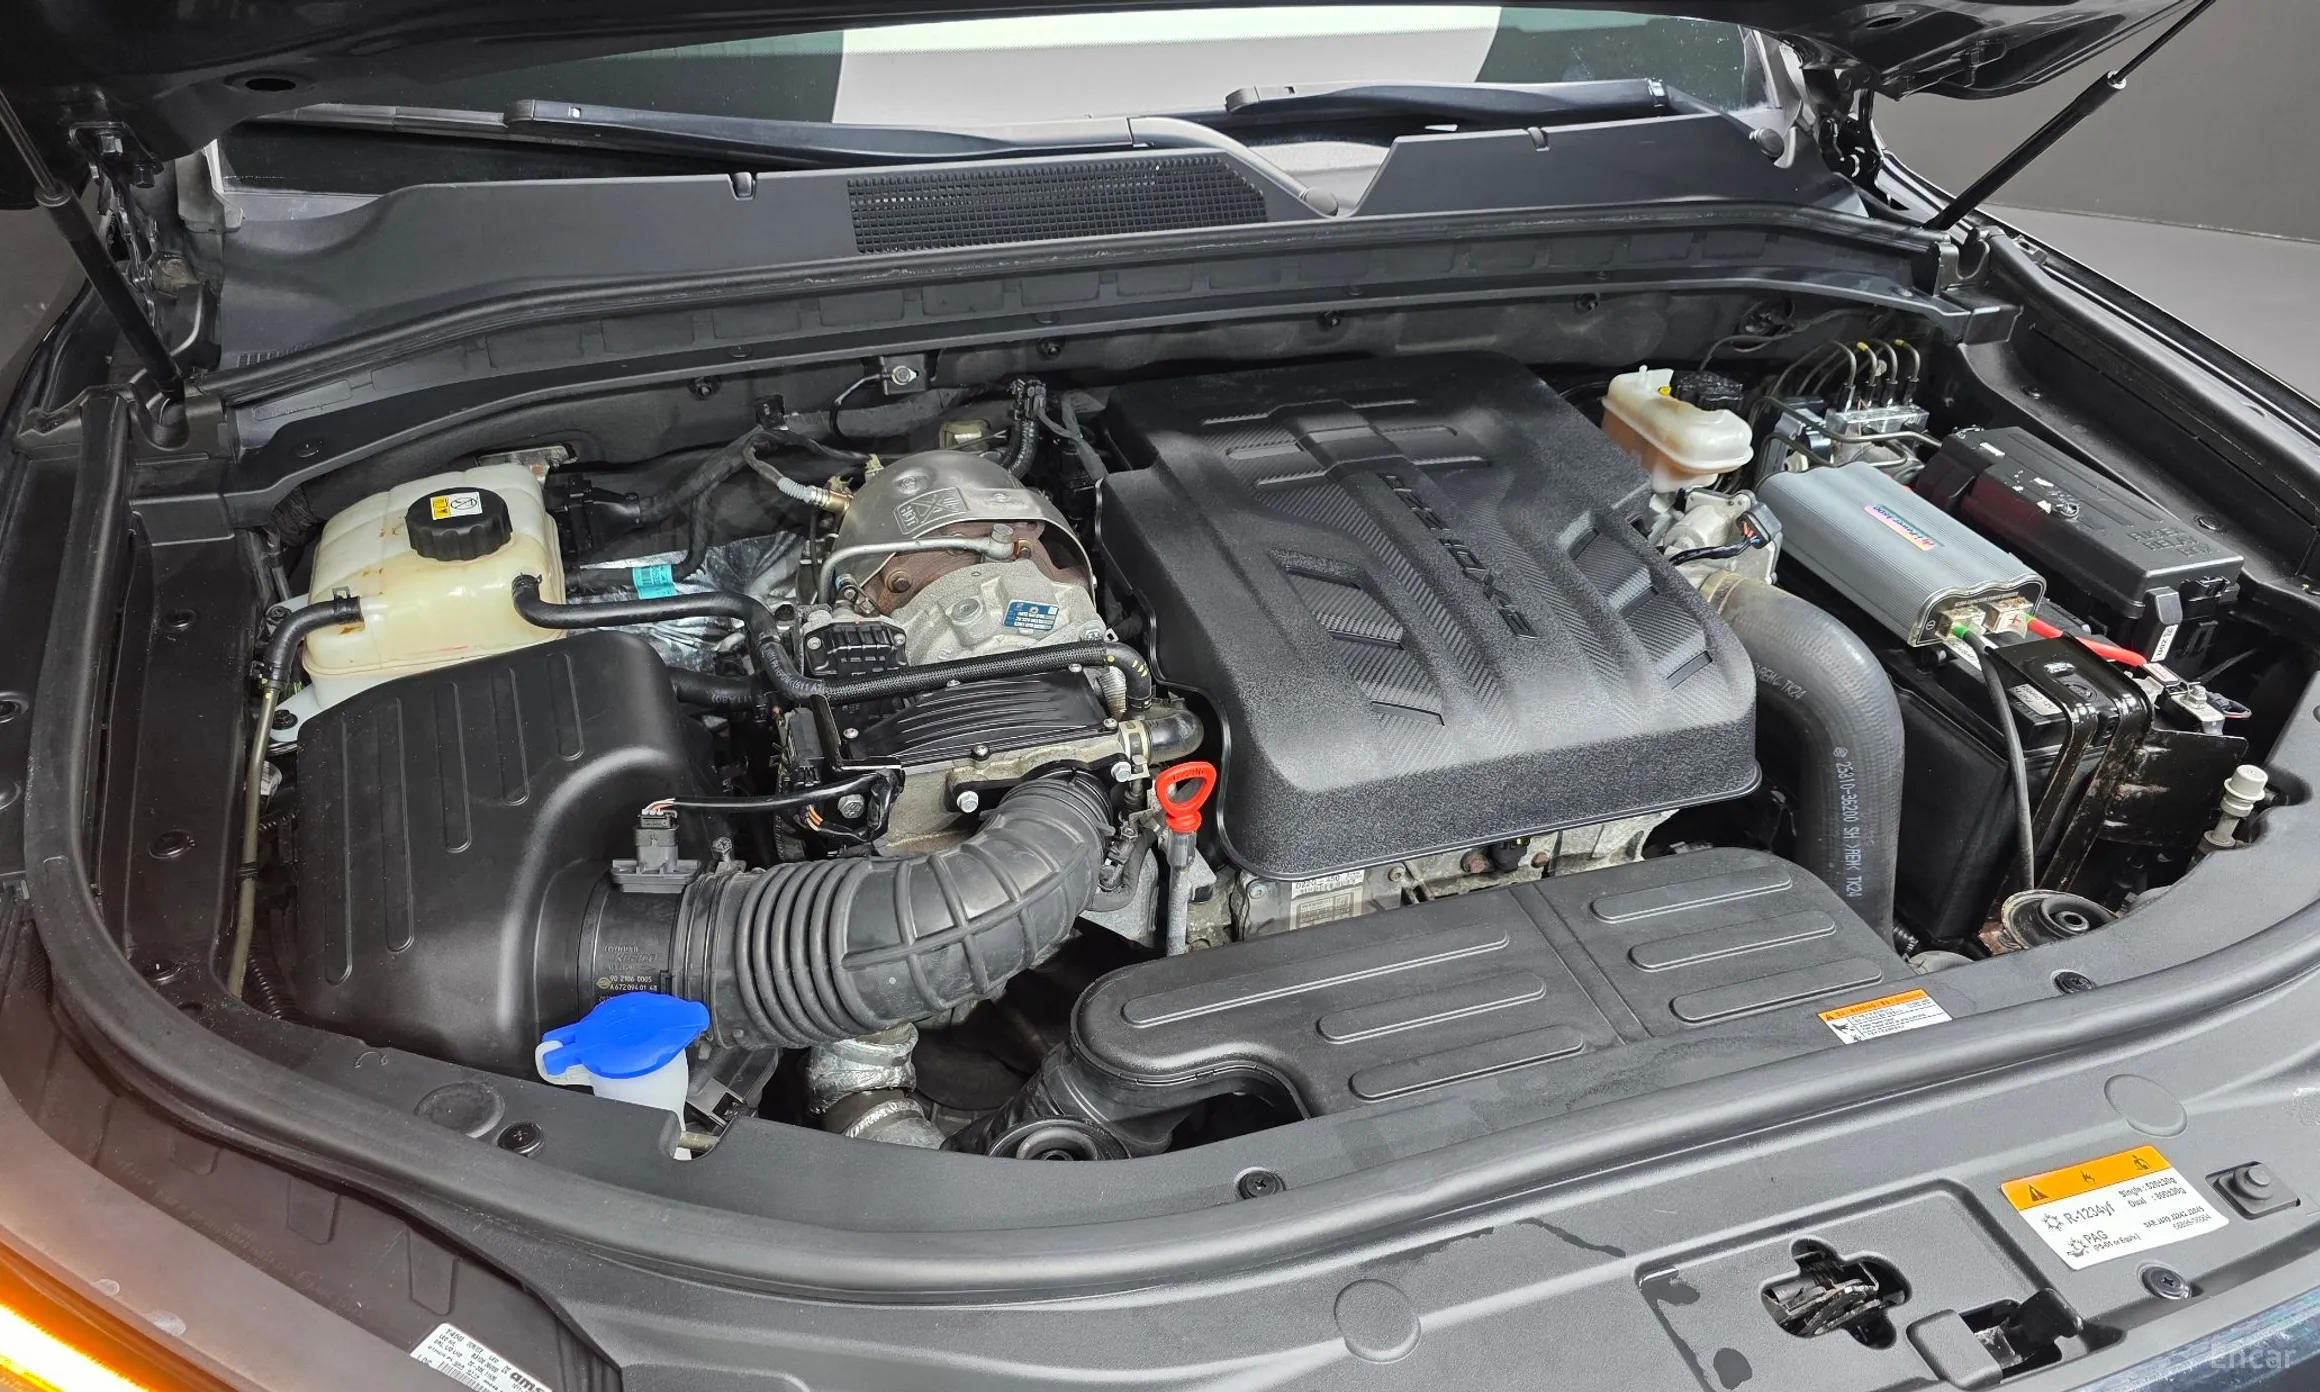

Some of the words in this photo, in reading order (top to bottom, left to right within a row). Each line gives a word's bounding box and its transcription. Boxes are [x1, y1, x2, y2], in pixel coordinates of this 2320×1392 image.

[1836, 761, 1860, 823] 25810-36200
[1846, 876, 1863, 897] TK24
[2128, 1196, 2147, 1207] Dual
[2063, 1200, 2116, 1225] R-1234yf
[2083, 1230, 2109, 1244] PAG
